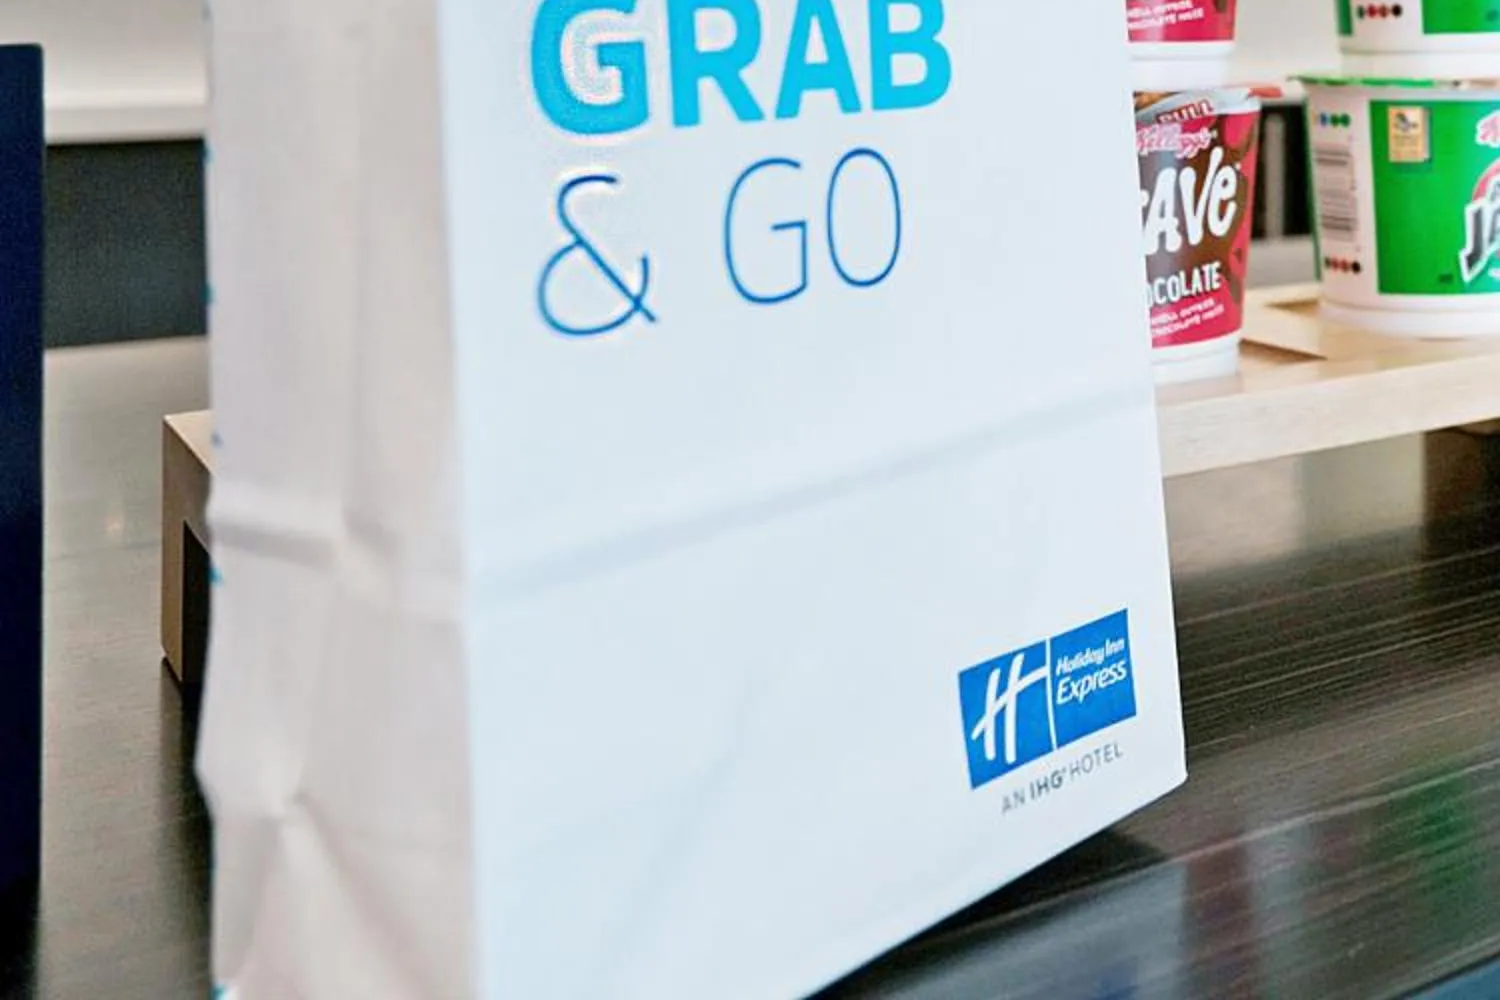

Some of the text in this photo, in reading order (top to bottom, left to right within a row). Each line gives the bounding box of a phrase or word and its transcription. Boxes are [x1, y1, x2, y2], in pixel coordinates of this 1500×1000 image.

[537, 146, 902, 336] & GO
[1147, 261, 1221, 305] COLATE
[1056, 637, 1126, 676] Holiday Inn
[1056, 660, 1128, 705] Express
[1002, 787, 1026, 815] AN
[1070, 741, 1124, 779] HOTEL
